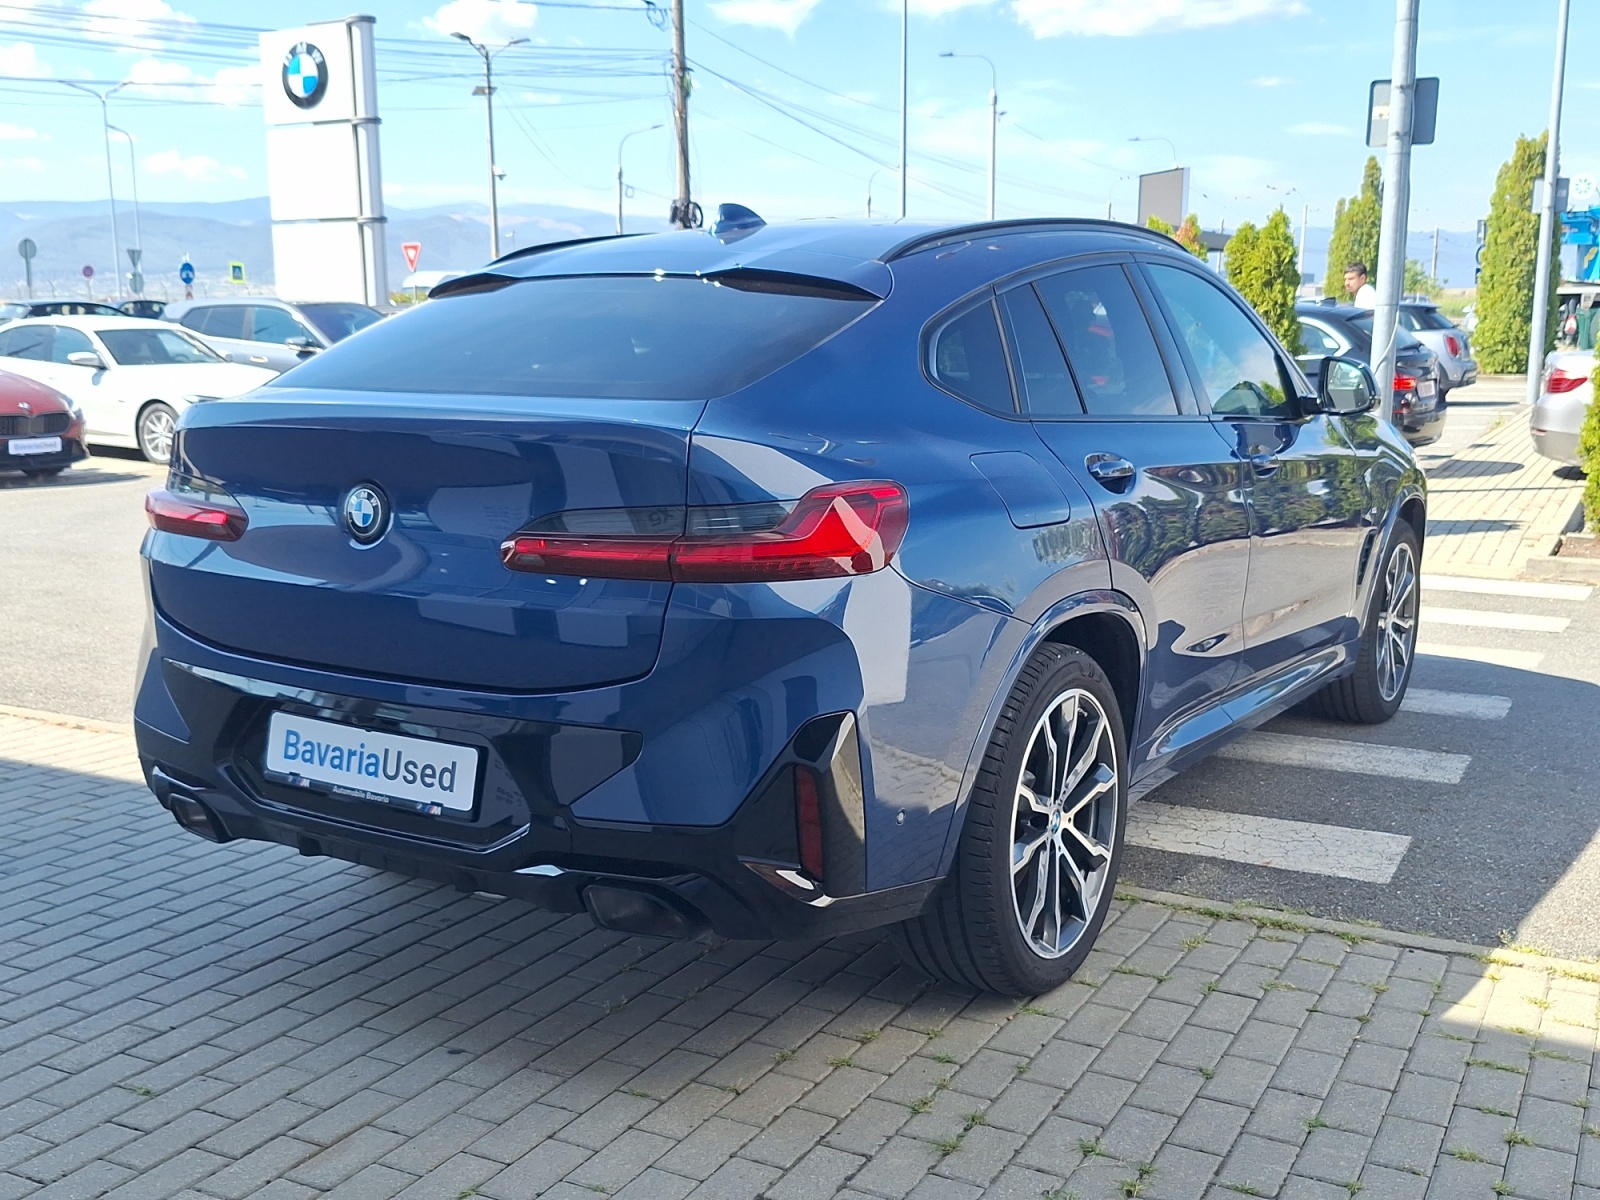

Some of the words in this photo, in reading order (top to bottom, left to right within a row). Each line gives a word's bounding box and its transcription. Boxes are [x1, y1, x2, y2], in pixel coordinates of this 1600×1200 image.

[283, 42, 324, 67] BMW
[350, 491, 379, 506] BMW
[283, 729, 458, 793] BavariaUsed
[332, 785, 365, 799] Automobile
[366, 791, 390, 804] Bavaria
